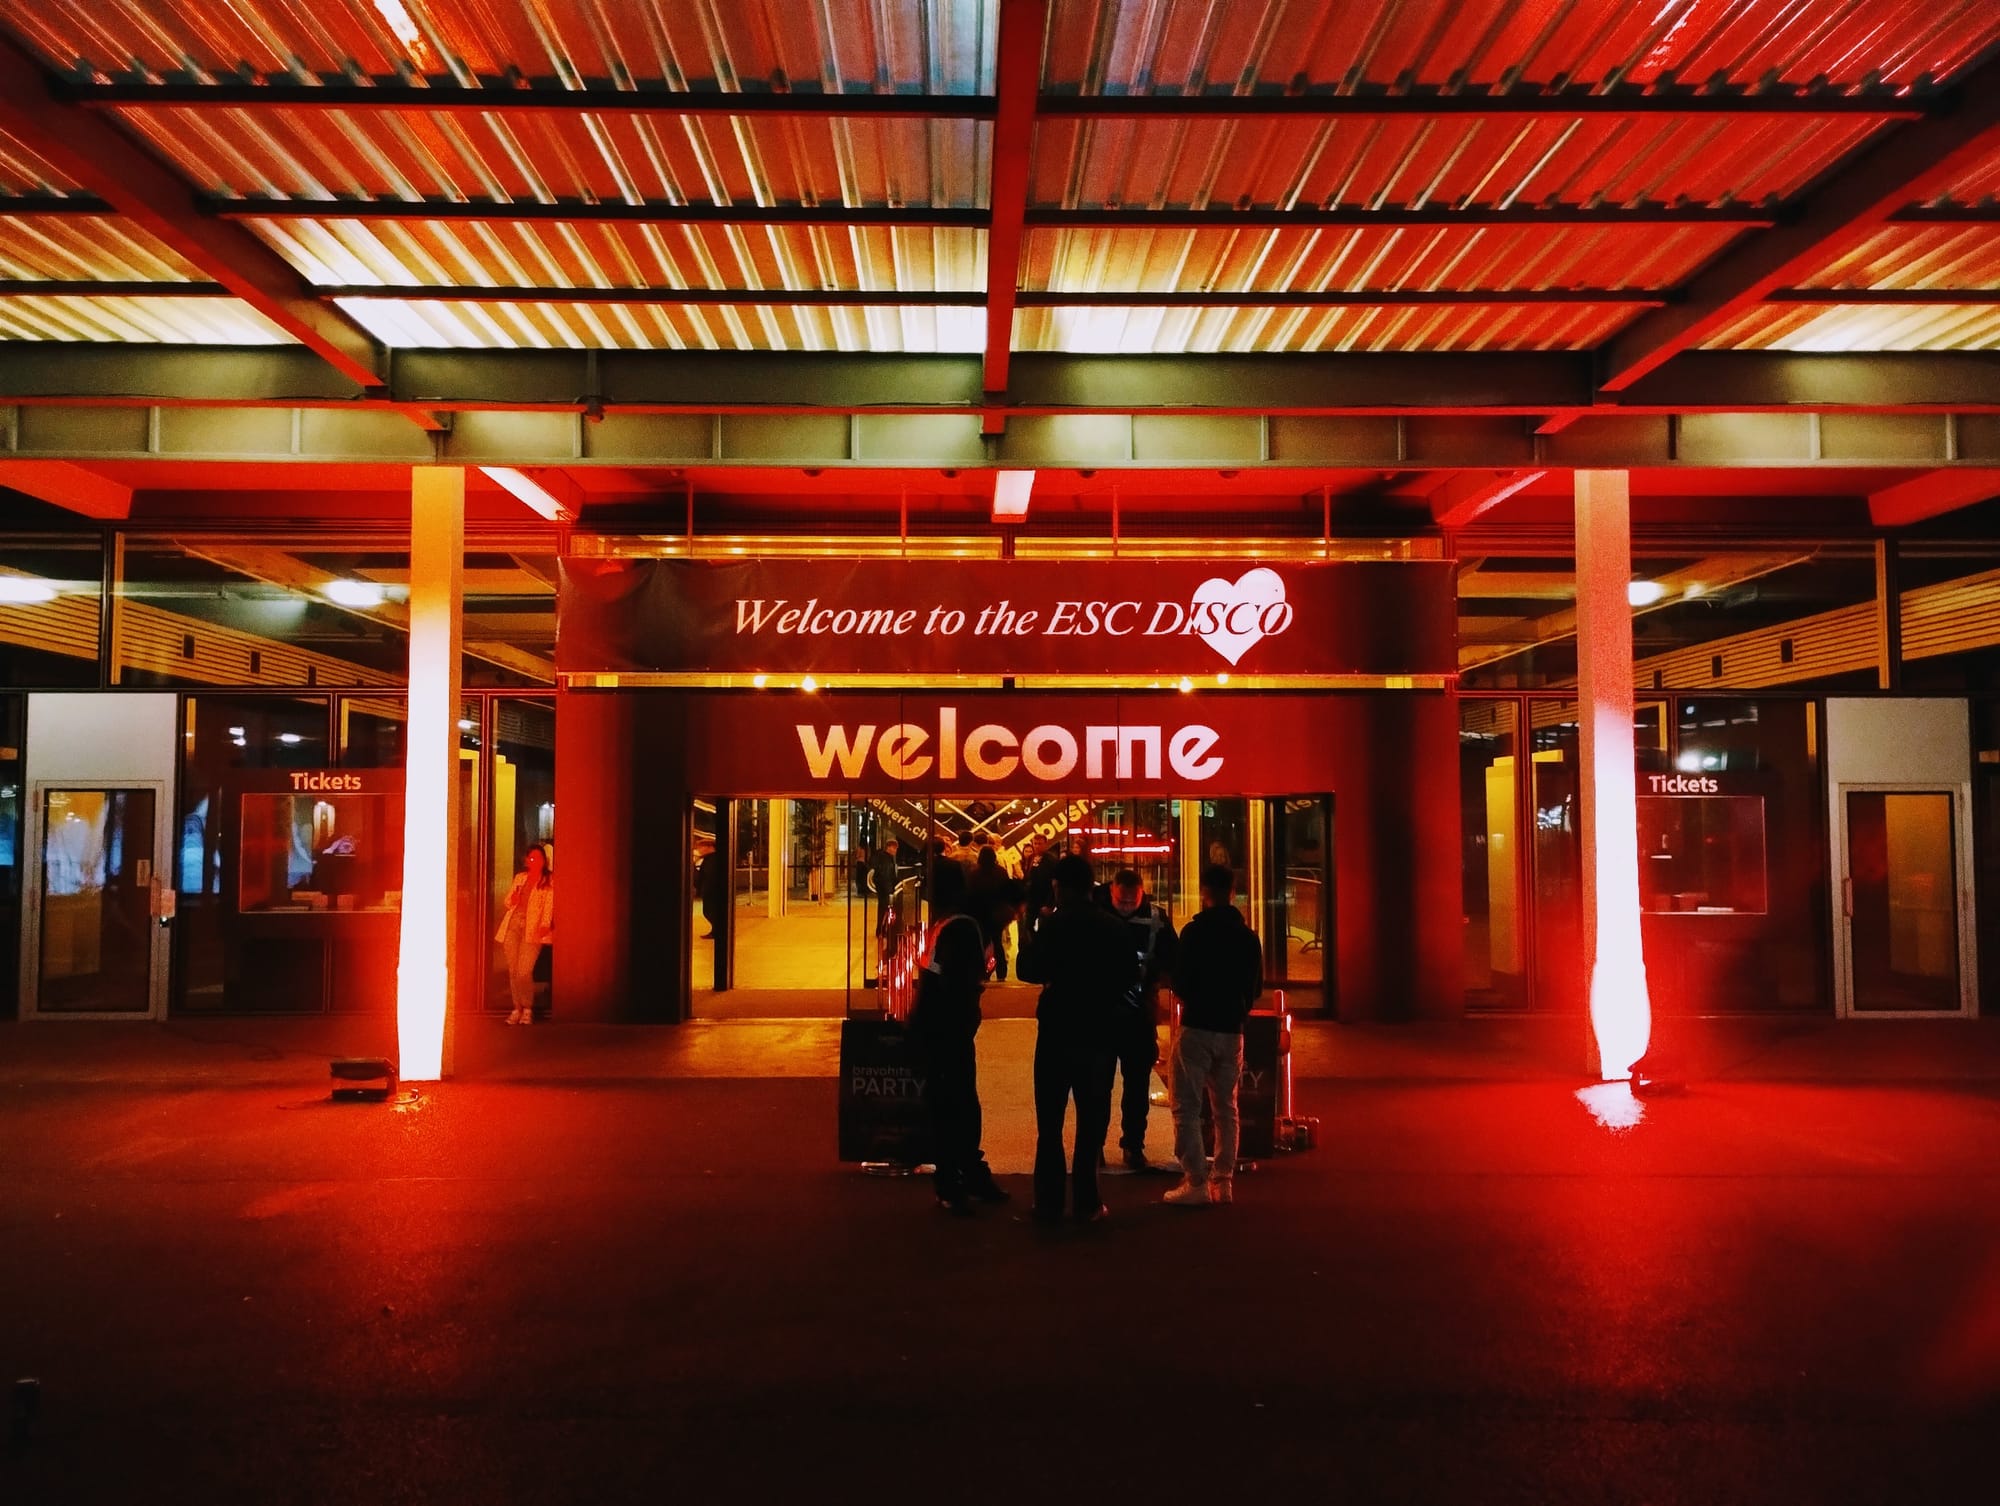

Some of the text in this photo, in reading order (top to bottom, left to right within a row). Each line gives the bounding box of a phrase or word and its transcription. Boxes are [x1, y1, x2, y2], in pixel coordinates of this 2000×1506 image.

[735, 598, 1293, 636] Welcome to the ESC DISCO
[796, 707, 1225, 780] welcome
[289, 771, 362, 790] Tickets
[1648, 774, 1719, 793] Tickets
[868, 798, 928, 841] elwerk.ch
[851, 1077, 928, 1097] PARTY
